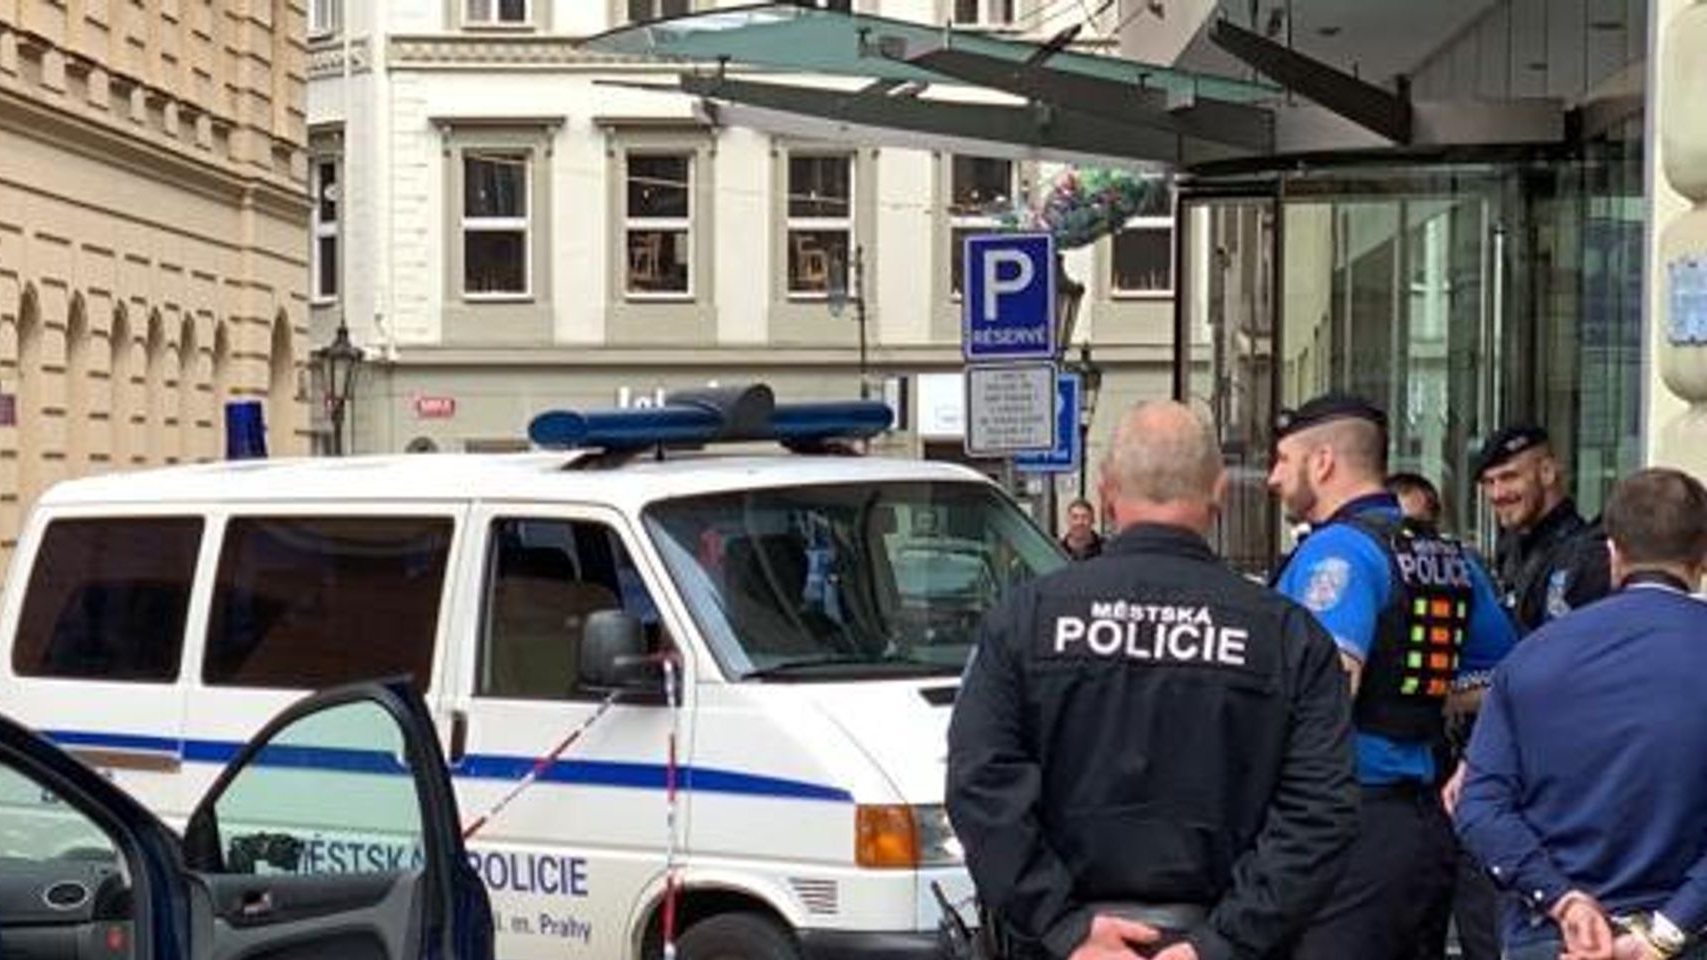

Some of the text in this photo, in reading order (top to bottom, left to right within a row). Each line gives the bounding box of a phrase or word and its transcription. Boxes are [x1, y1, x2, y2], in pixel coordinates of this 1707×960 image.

[983, 249, 1034, 321] P
[1091, 599, 1212, 625] MĚSTSKÁ
[1054, 616, 1249, 665] POLICIE
[540, 912, 592, 943] Prahy
